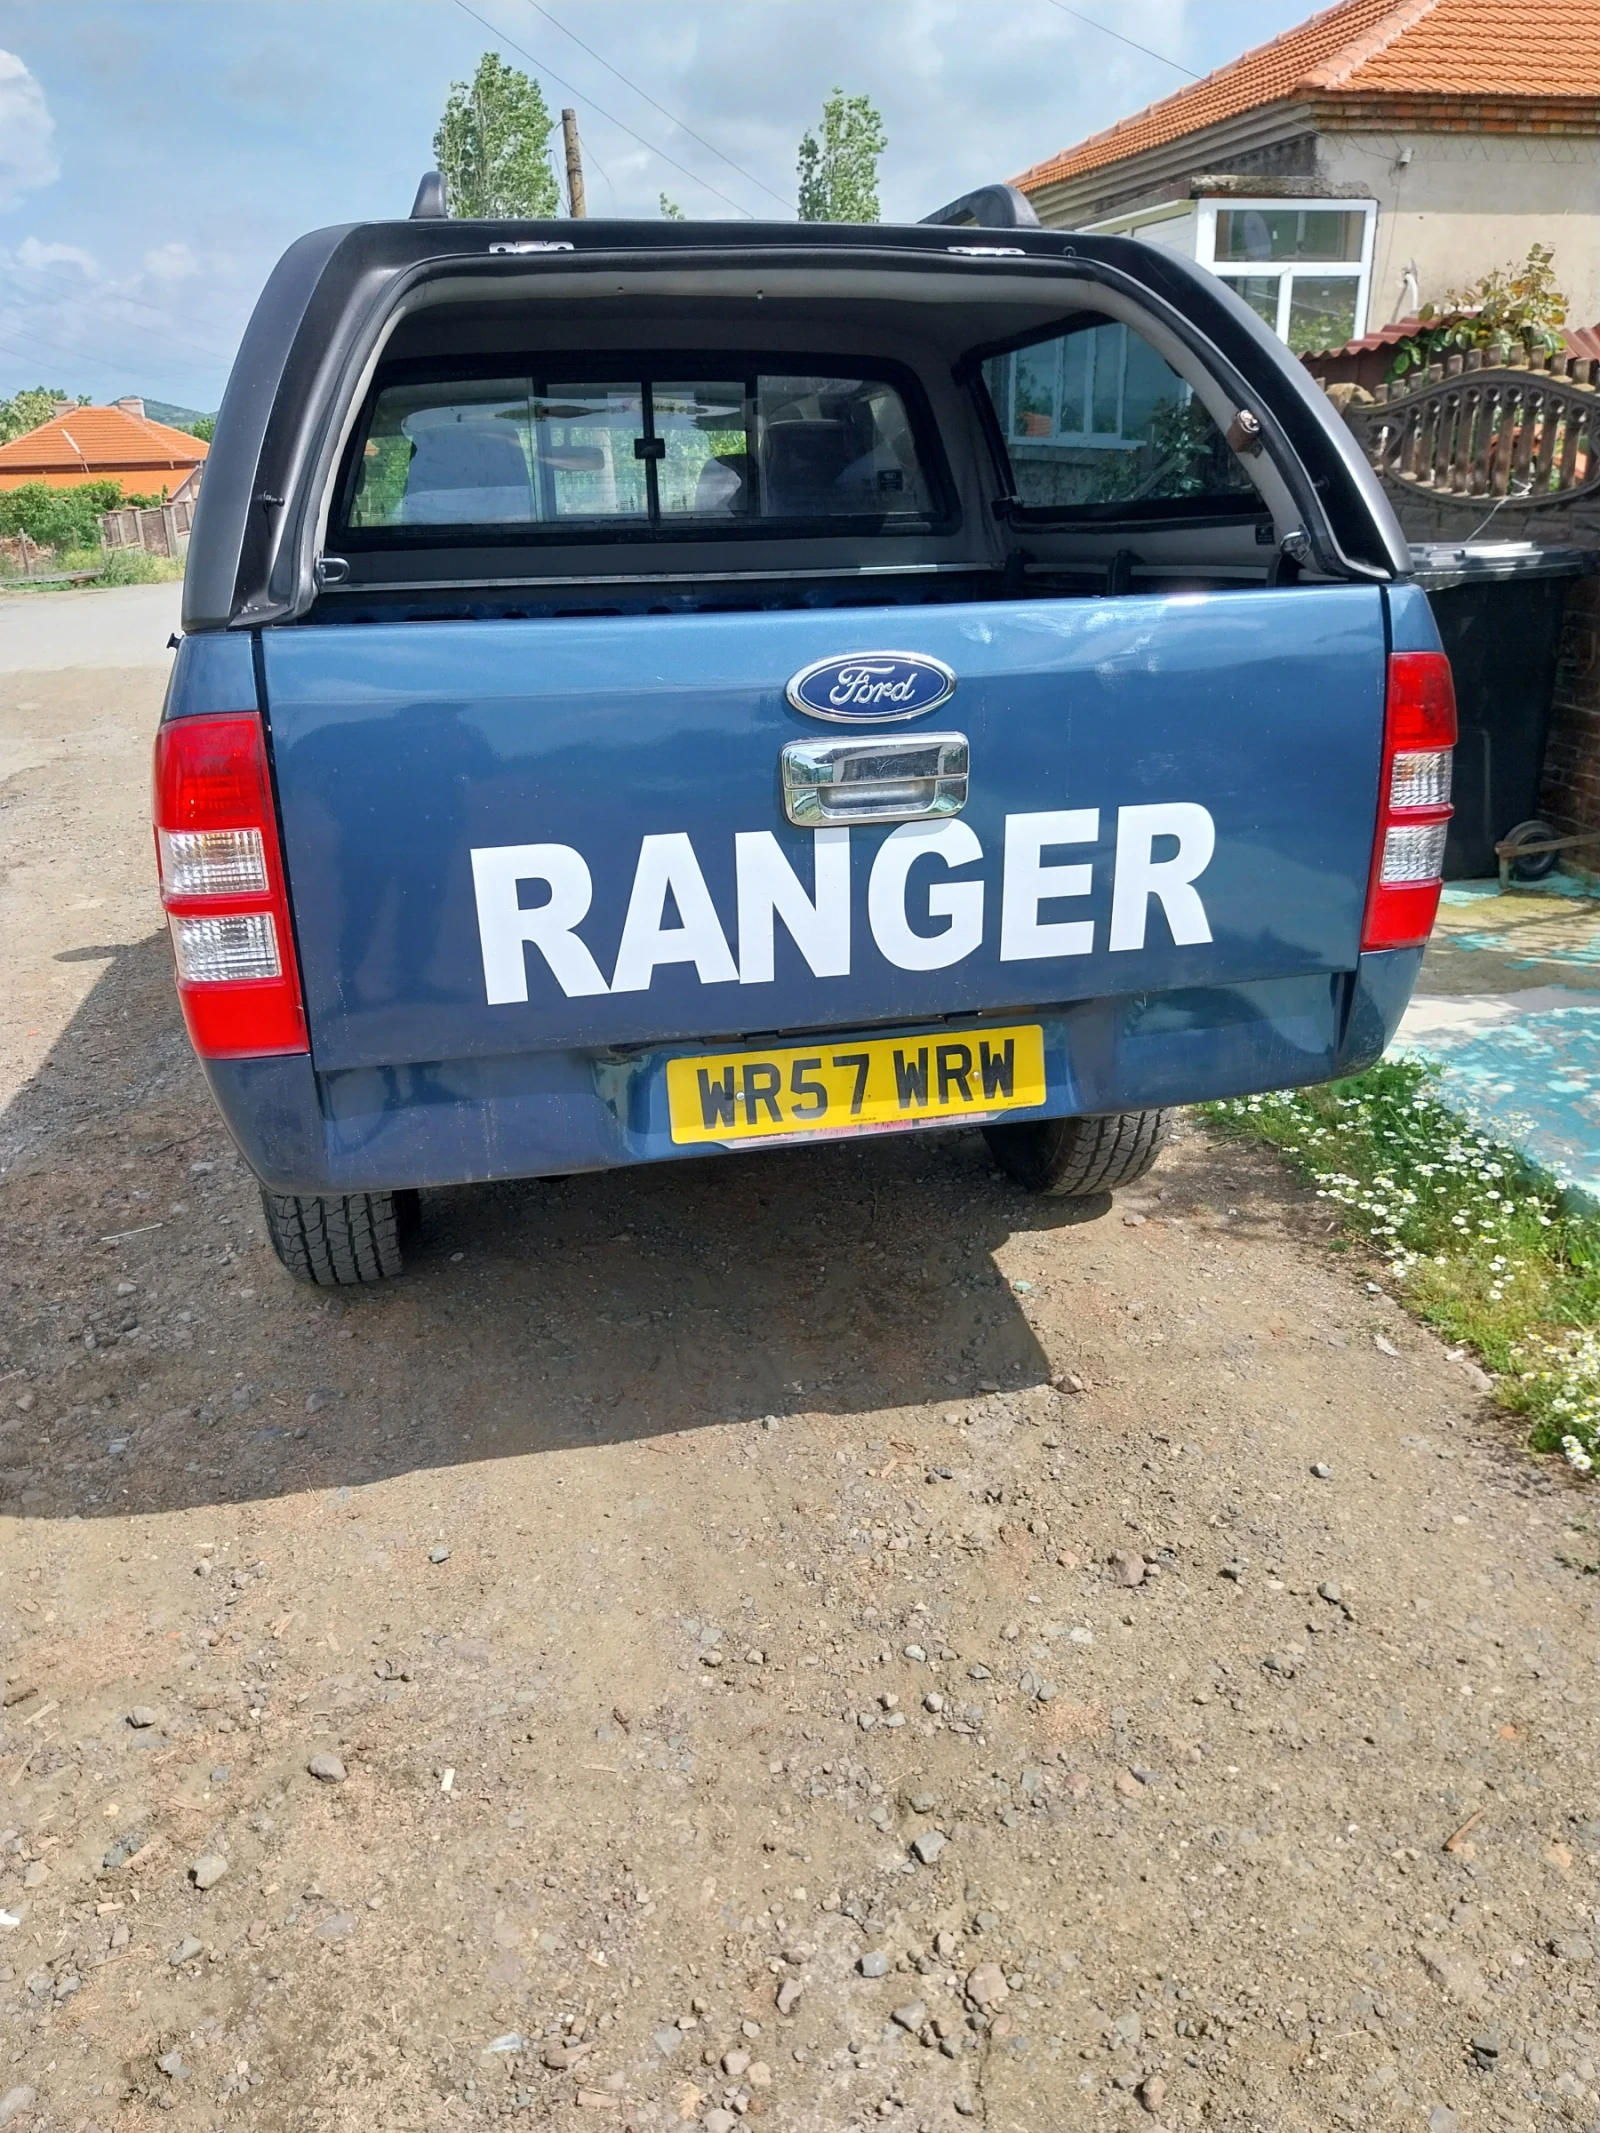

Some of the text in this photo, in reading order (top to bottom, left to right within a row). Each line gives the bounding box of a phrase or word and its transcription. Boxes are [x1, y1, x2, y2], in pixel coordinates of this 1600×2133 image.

[829, 665, 917, 705] Ford
[470, 801, 1215, 1005] RANGER
[696, 1038, 1015, 1130] WR57 WRW
